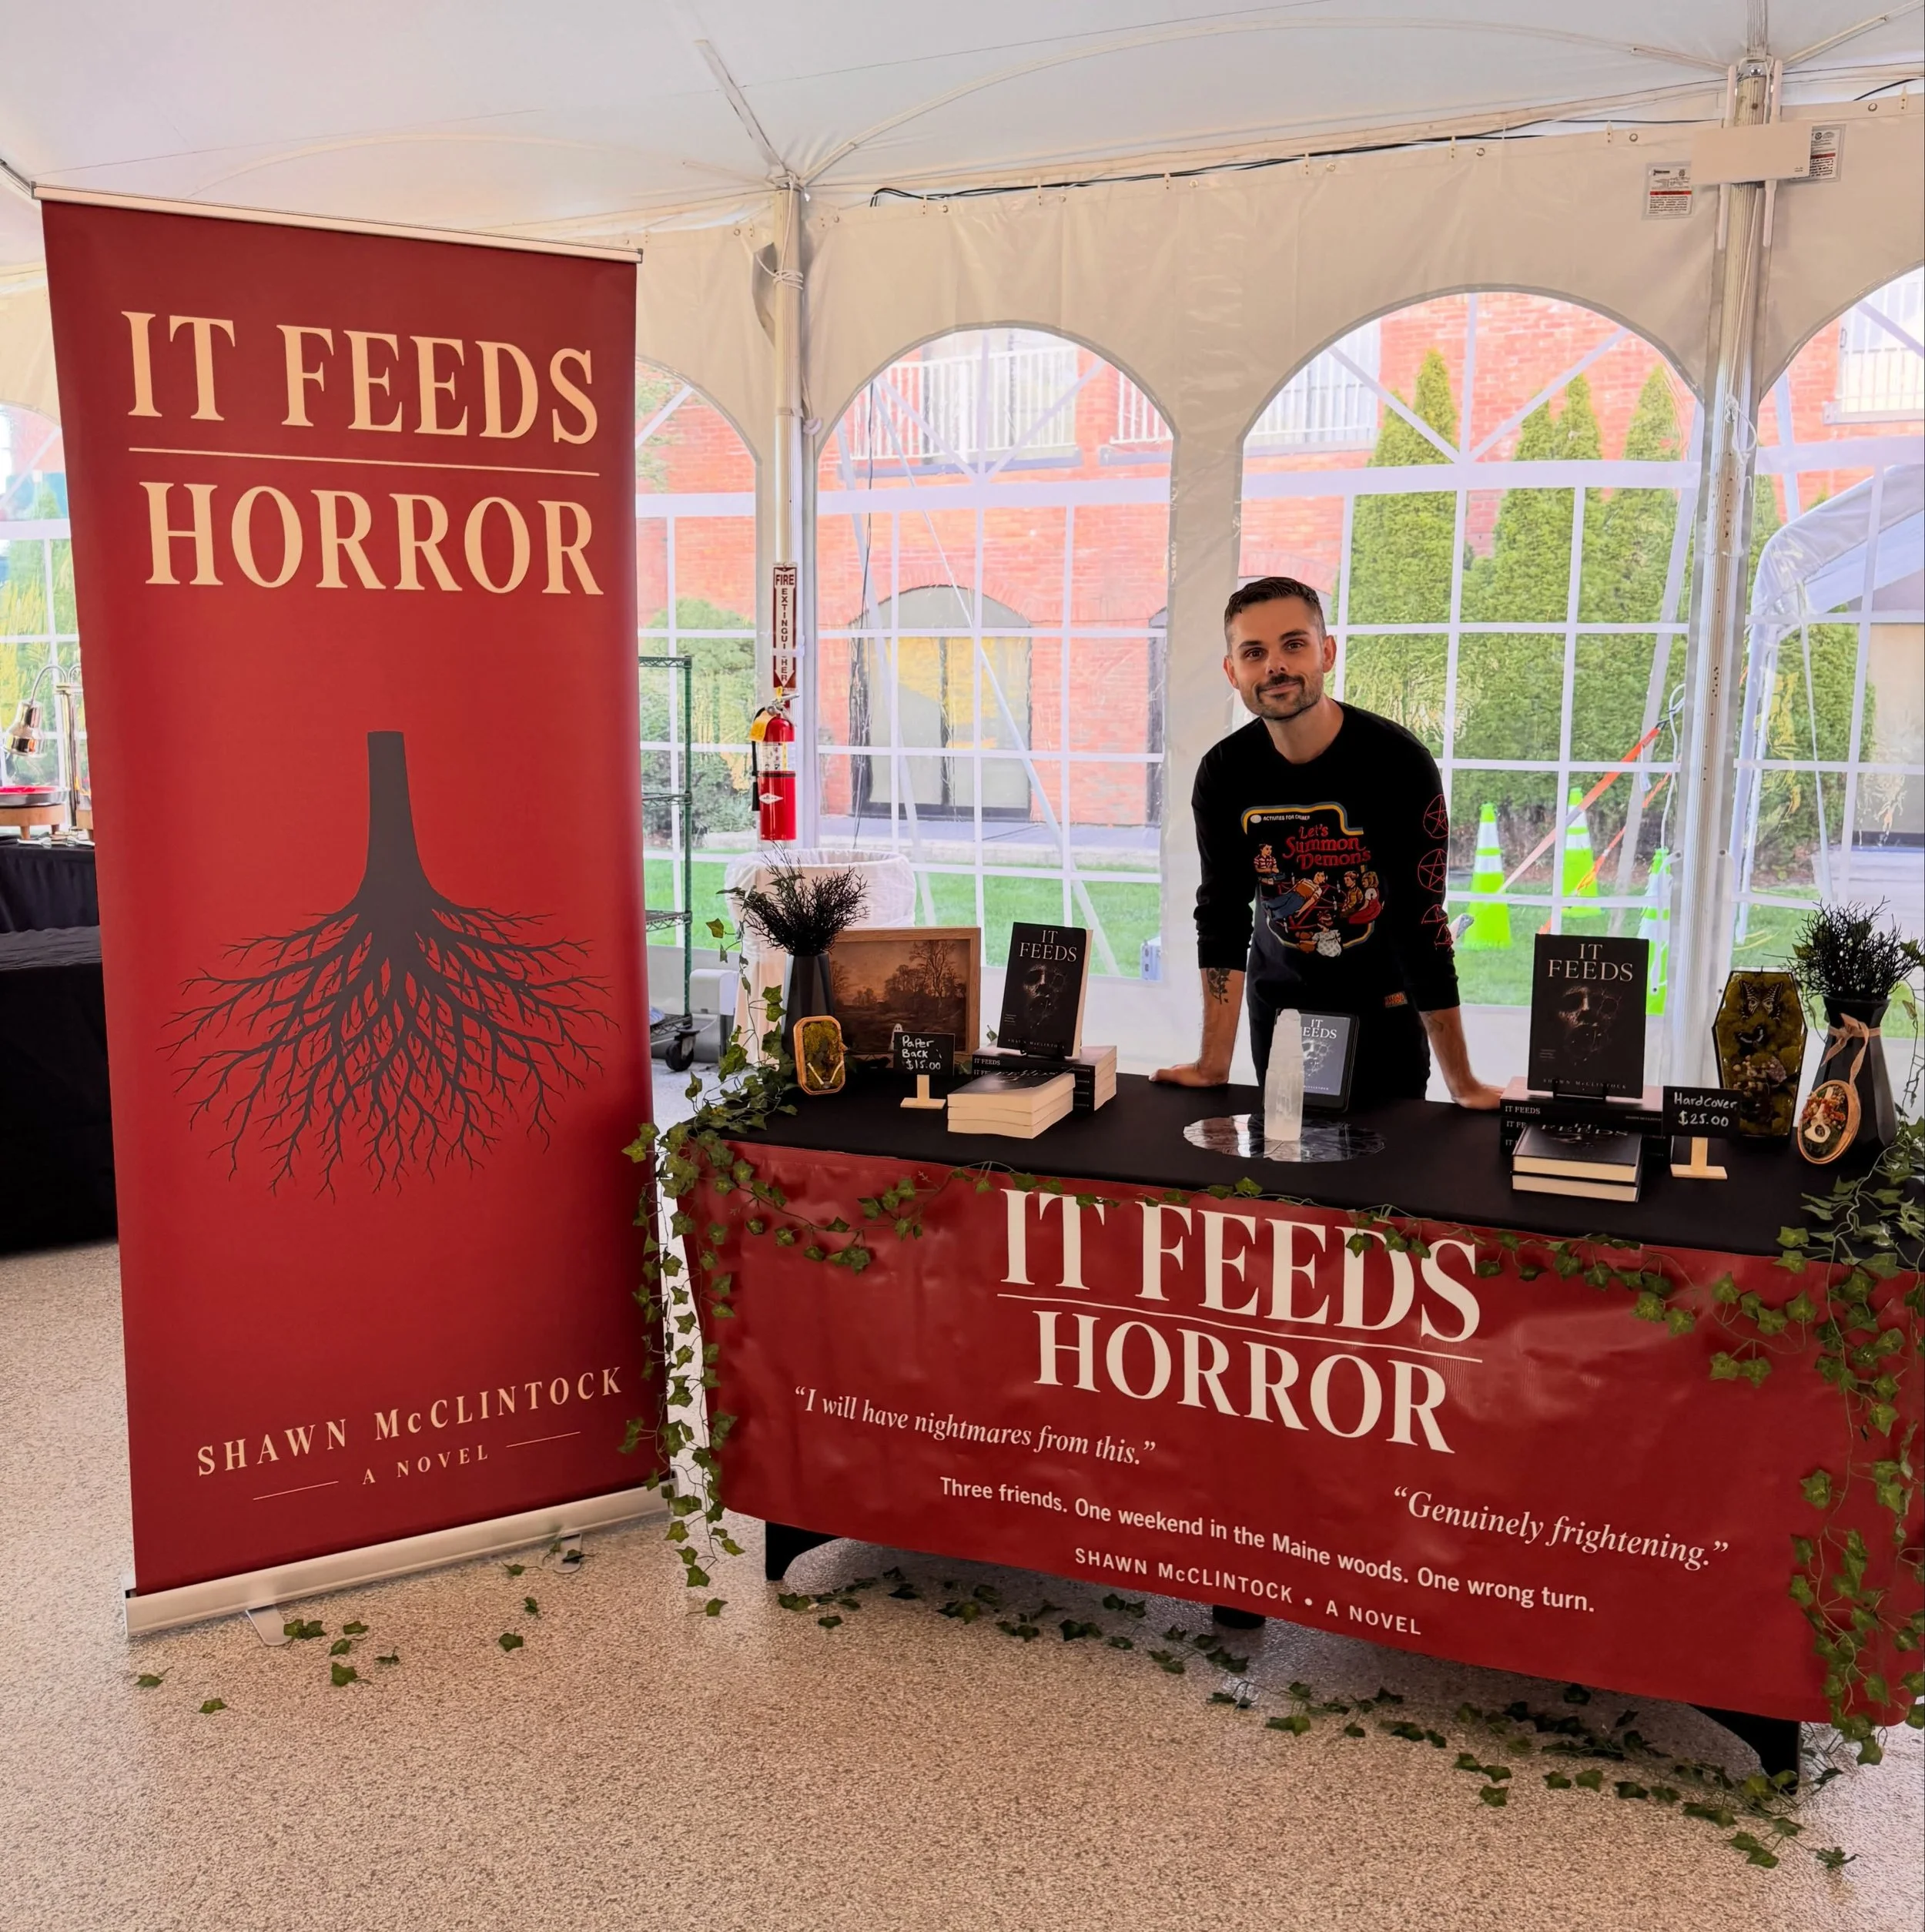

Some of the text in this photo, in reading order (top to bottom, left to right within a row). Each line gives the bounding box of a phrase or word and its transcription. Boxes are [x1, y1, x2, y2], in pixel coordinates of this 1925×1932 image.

[122, 312, 597, 444] IT FEEDS
[139, 482, 603, 594] HORROR
[775, 574, 795, 585] FIRE
[1299, 824, 1329, 839] Let's
[1282, 836, 1366, 859] Summon
[1297, 850, 1371, 869] Demons
[1042, 929, 1058, 943] IT
[1019, 942, 1077, 963] FEEDS
[1579, 943, 1603, 960] IT
[1548, 959, 1633, 982] FEEDS
[1302, 1026, 1337, 1039] EEDS
[1311, 1019, 1324, 1028] IT
[902, 1049, 929, 1058] Back
[906, 1060, 941, 1070] $15.00
[1515, 1106, 1541, 1115] FEEDS
[1678, 1110, 1729, 1127] $25.00
[1001, 1189, 1480, 1343] IT FEEDS
[1033, 1311, 1455, 1453] HORROR
[198, 1368, 621, 1475] SHAWN McCLINTOCK
[823, 1397, 856, 1419] will
[863, 1400, 908, 1428] have
[916, 1413, 1031, 1445] nightmares
[1034, 1426, 1087, 1454] from
[1096, 1436, 1155, 1464] this.”
[363, 1445, 487, 1484] A NOVEL
[1394, 1487, 1728, 1570] “Genuinely frightening.”
[941, 1477, 1593, 1612] Three friends. One weekend in the Maine woods. One wrong turn.
[1076, 1549, 1421, 1634] SHAWN McCLINTOCK A NOVEL
